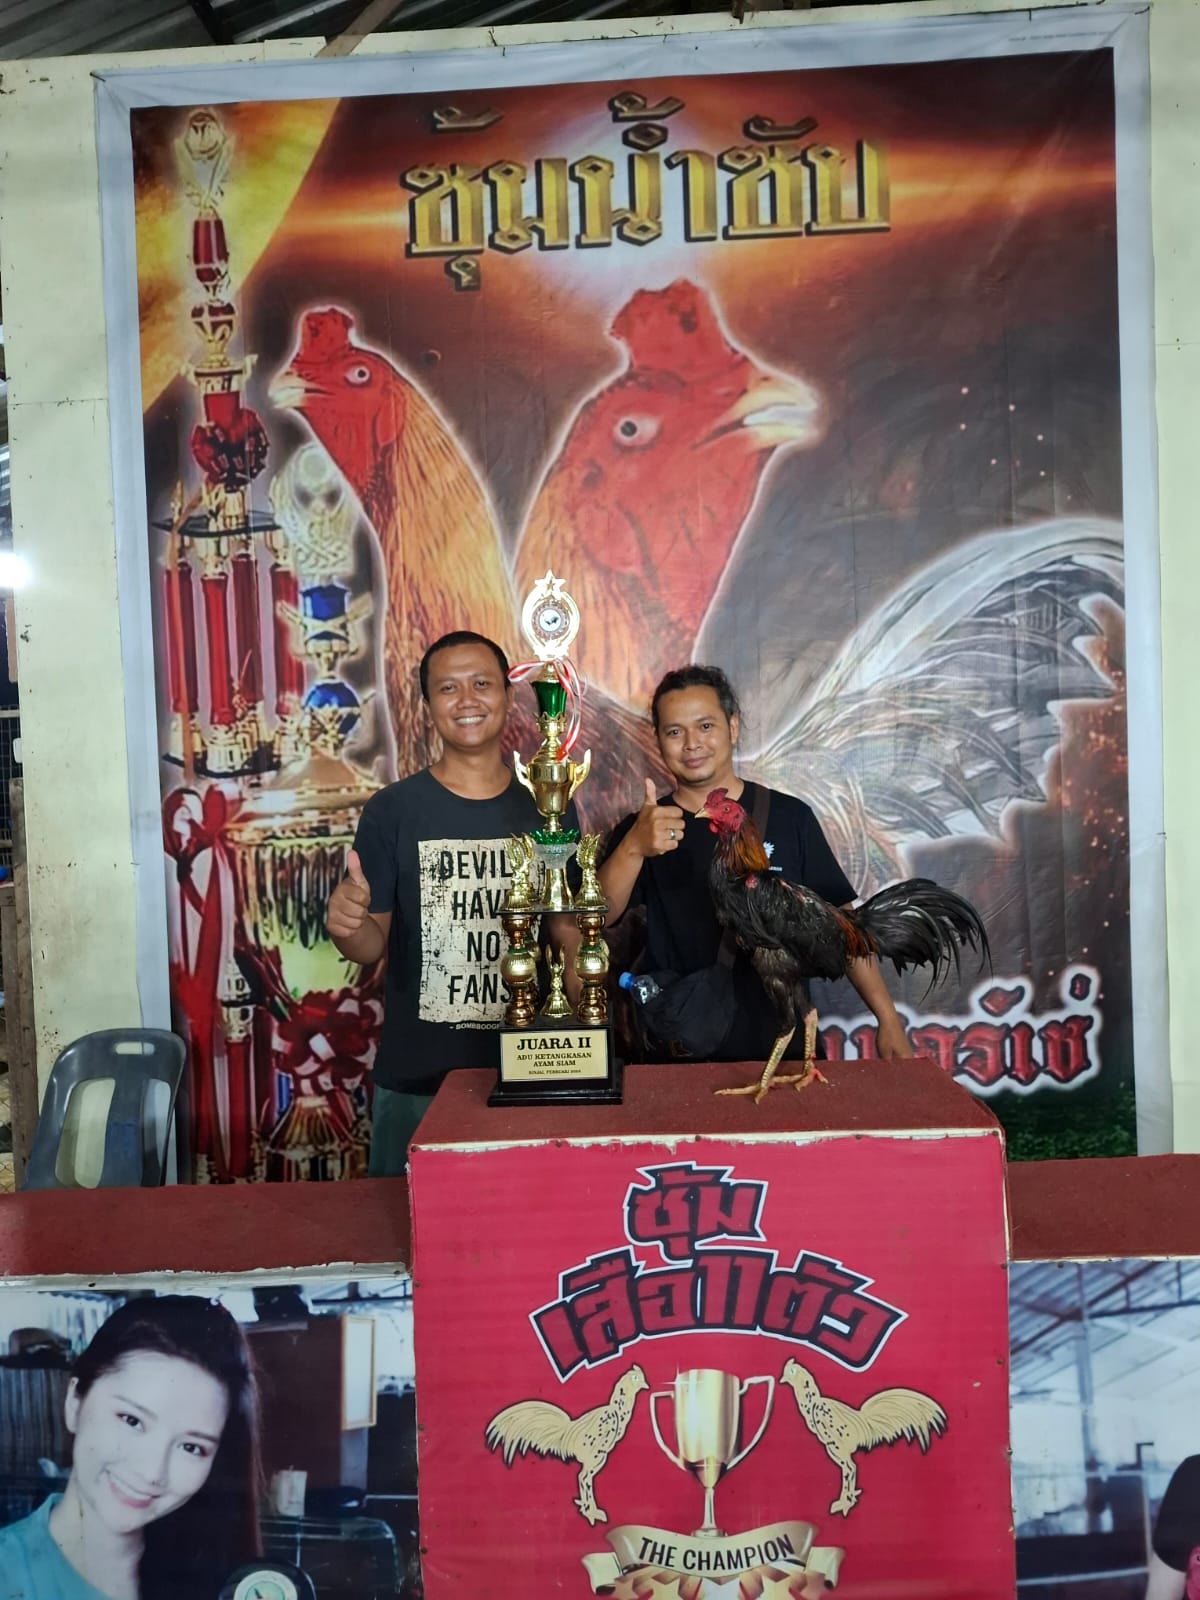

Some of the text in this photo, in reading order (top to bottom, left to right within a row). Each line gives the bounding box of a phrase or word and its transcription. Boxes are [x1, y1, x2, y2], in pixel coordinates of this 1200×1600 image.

[452, 889, 507, 921] HAV
[466, 930, 500, 962] NO
[516, 1036, 592, 1051] JUARA II
[535, 1052, 592, 1060] KETANGKASAN
[637, 1533, 796, 1571] THE CHAMPION
